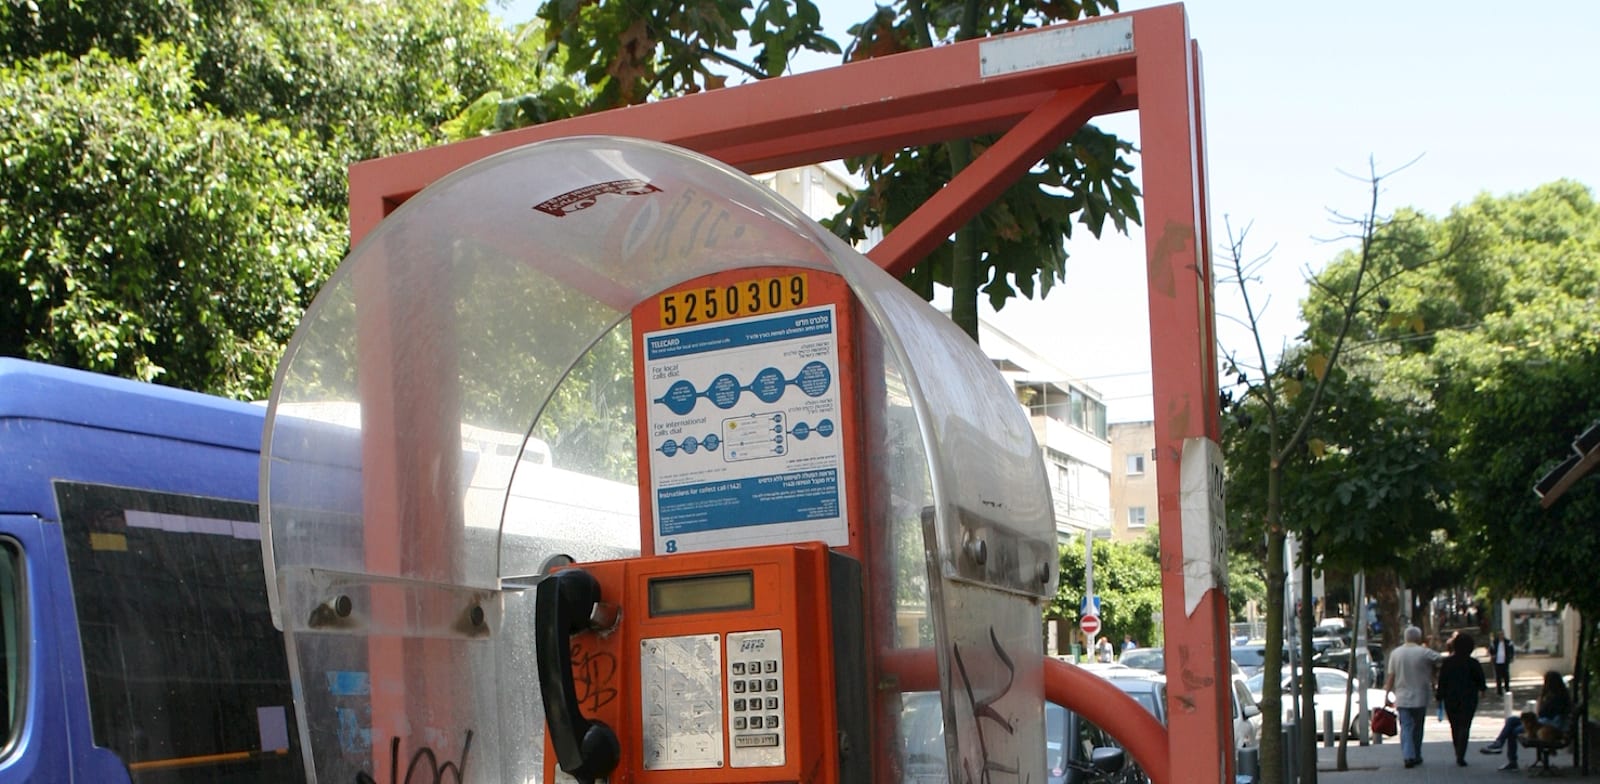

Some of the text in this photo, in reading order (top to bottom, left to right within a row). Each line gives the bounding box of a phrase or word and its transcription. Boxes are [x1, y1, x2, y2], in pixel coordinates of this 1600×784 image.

[664, 276, 804, 325] 5250309
[651, 338, 680, 348] TELECARD
[667, 370, 680, 378] dial
[666, 416, 707, 428] international
[654, 429, 669, 437] calls
[717, 484, 727, 492] call
